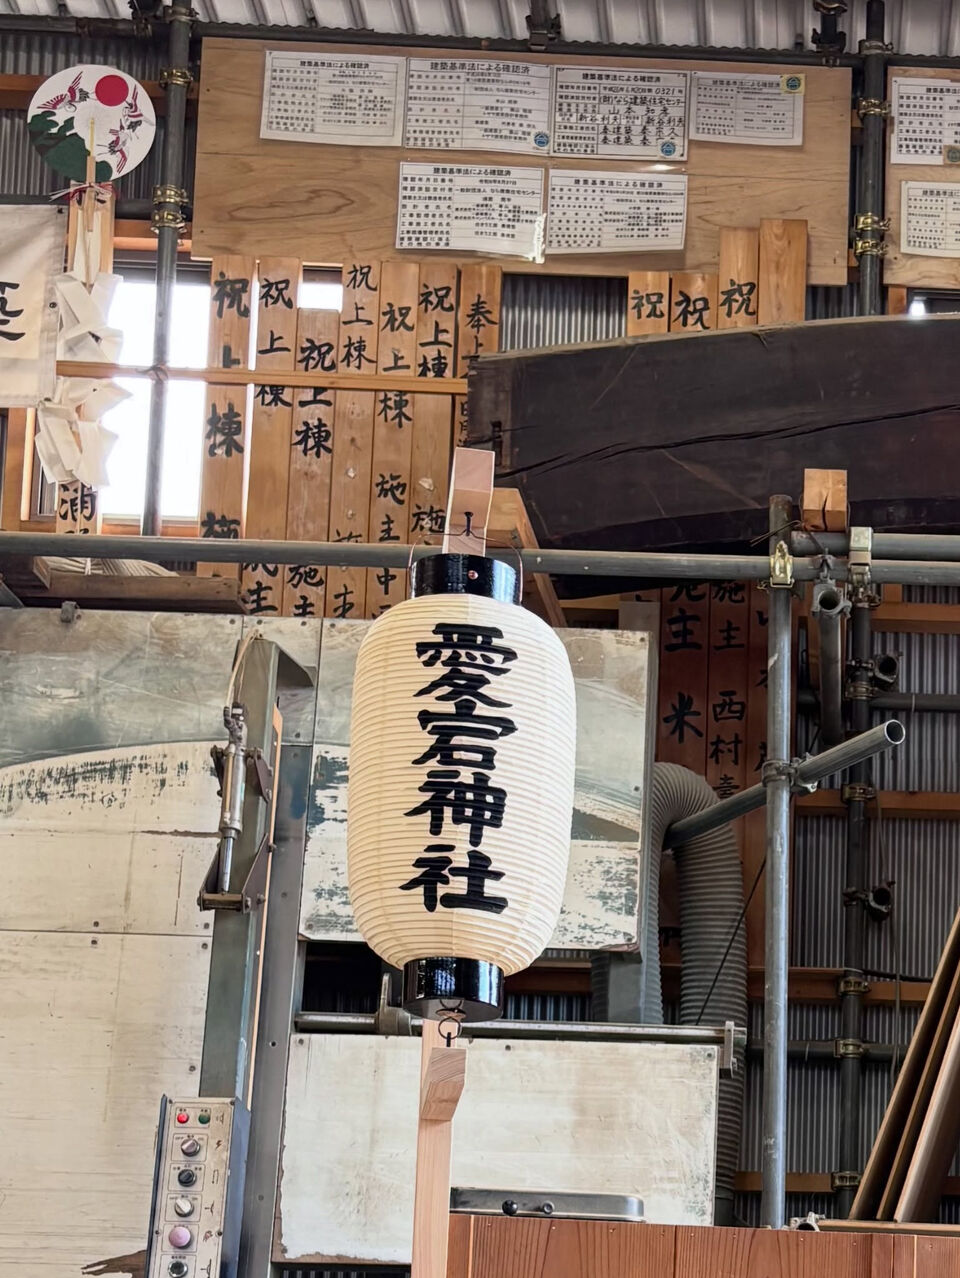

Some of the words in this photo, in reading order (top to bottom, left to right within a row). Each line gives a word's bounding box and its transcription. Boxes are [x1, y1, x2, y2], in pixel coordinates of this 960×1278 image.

[430, 62, 530, 74] 建築基準法による確認済
[433, 166, 512, 176] 建築基準法による確認済
[339, 263, 378, 371] 祝上棟
[630, 289, 666, 321] 祝
[671, 290, 712, 330] 祝
[719, 278, 757, 319] 祝
[417, 283, 455, 378] 祝上棟
[377, 302, 415, 429] 祝上棟
[662, 691, 704, 744] 米
[398, 622, 519, 915] 愛宕神社
